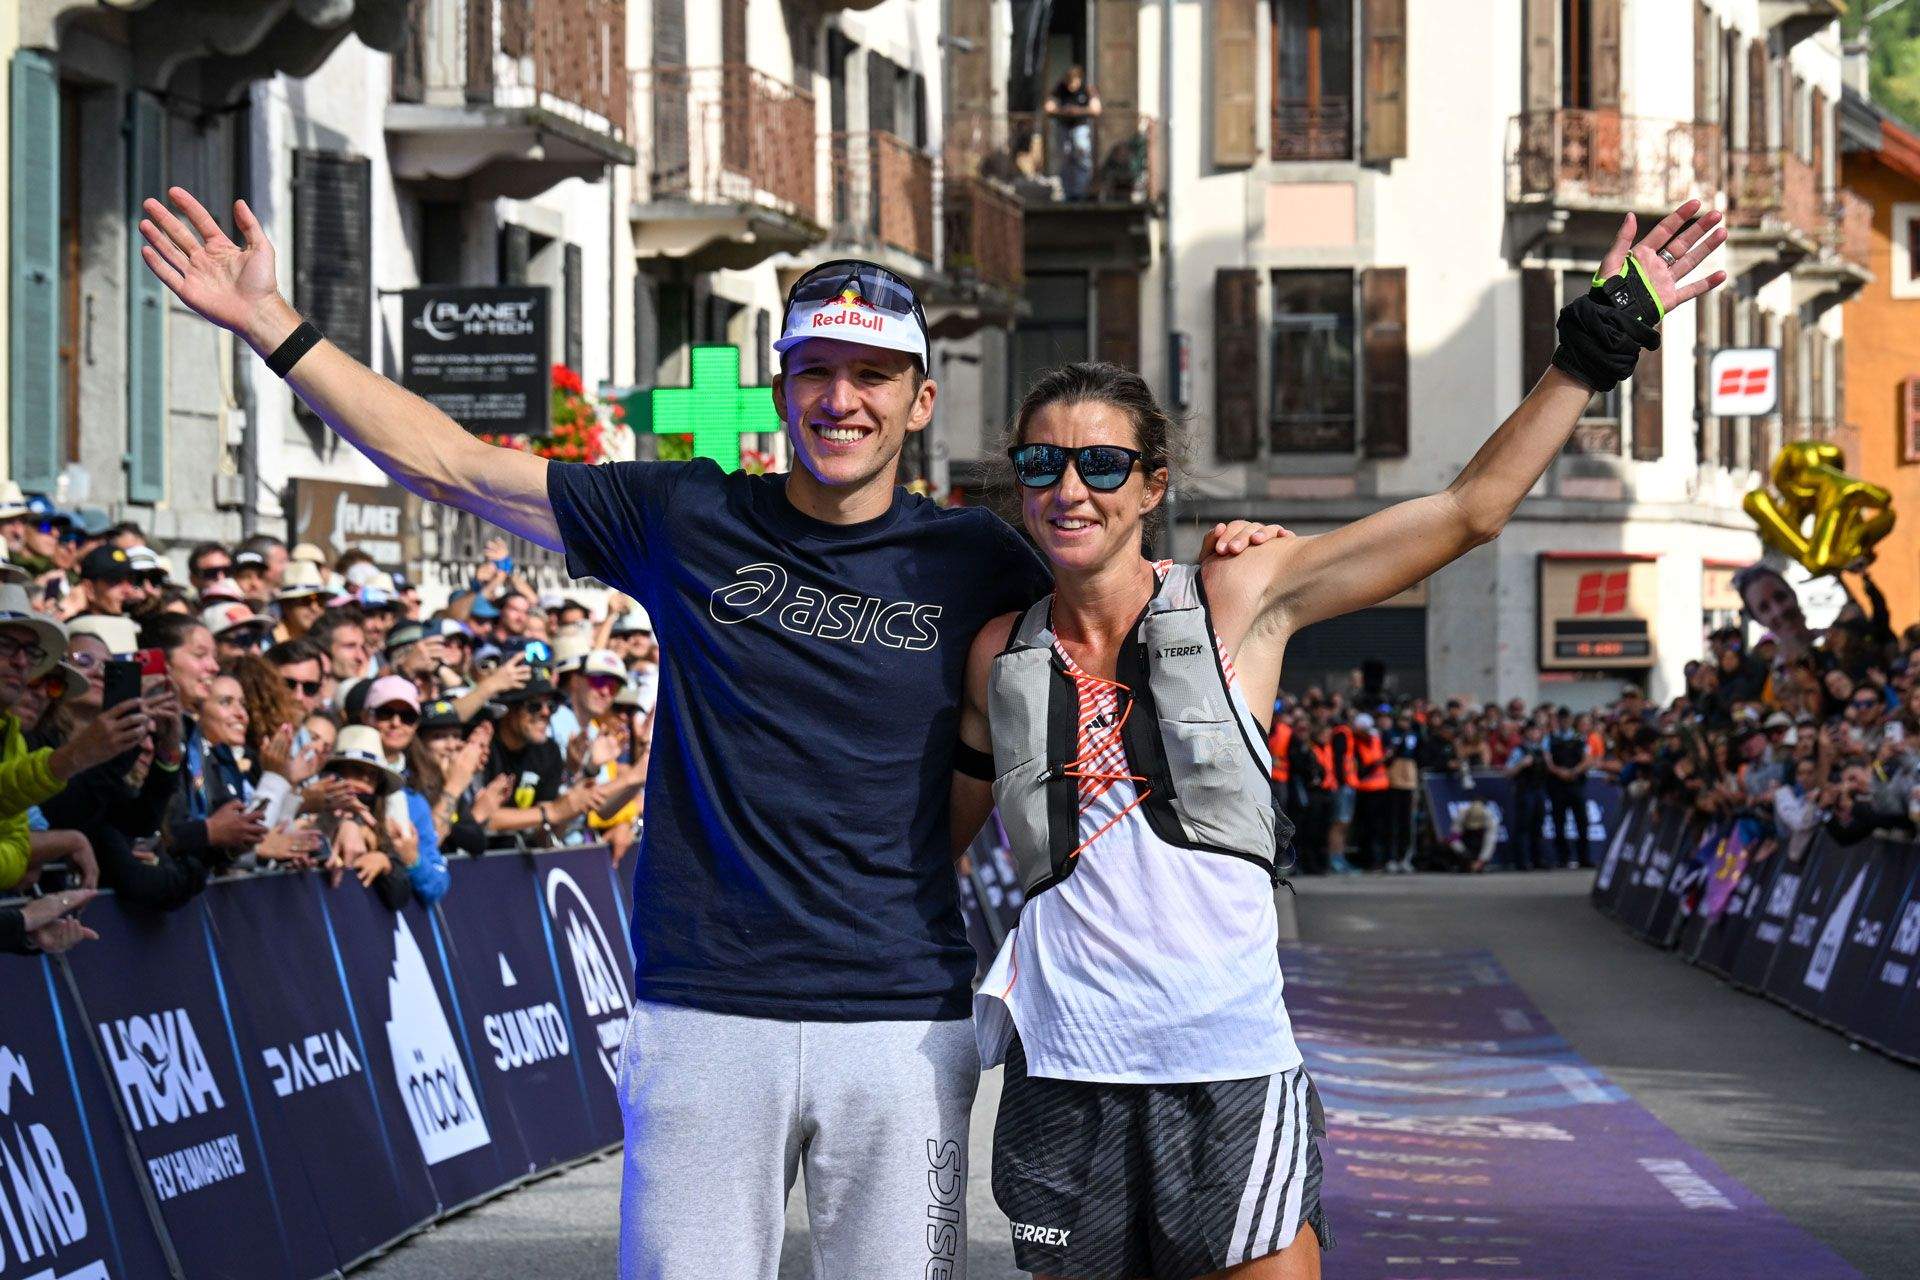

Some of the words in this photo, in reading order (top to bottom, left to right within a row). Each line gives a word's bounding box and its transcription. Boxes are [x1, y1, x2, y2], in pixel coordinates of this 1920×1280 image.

[436, 302, 532, 321] PLANET
[812, 310, 847, 328] Red
[849, 312, 884, 332] Bull
[1163, 644, 1203, 658] TERREX
[99, 1008, 225, 1132] HOKA
[261, 1029, 362, 1098] DACIA
[483, 1001, 569, 1072] SUUNTO
[0, 1121, 88, 1259] TMB
